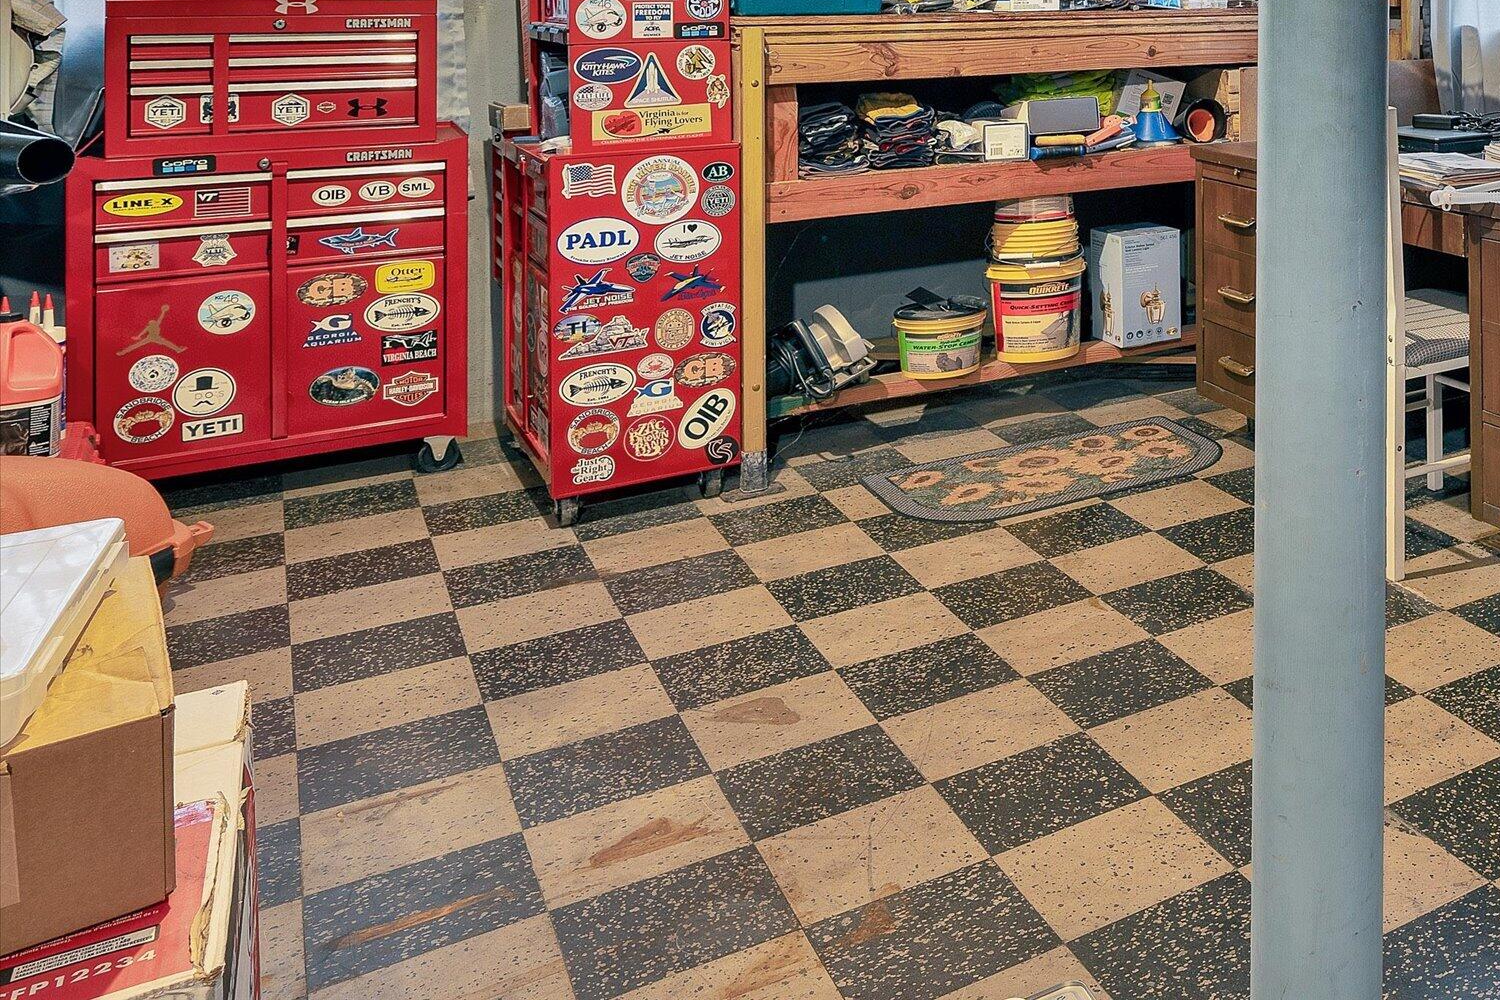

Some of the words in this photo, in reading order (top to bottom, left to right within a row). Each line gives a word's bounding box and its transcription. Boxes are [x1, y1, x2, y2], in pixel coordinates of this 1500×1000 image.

[346, 18, 412, 29] CRAFTSMAN
[602, 62, 627, 70] HAWK
[592, 69, 615, 77] KITES
[150, 108, 181, 116] YETI
[277, 106, 305, 114] YETI
[638, 110, 676, 119] Virginia
[644, 118, 673, 127] Flying
[674, 116, 703, 125] Lovers
[346, 149, 412, 162] CRAFTSMAN
[162, 159, 208, 167] GoPro
[708, 165, 729, 178] AB
[366, 185, 390, 197] VB
[402, 182, 431, 192] SML
[197, 192, 219, 202] VT
[318, 189, 346, 201] OIB
[682, 224, 686, 233] I
[566, 230, 632, 251] PADL
[684, 251, 707, 260] NOISE
[307, 278, 356, 300] CB
[1028, 283, 1070, 296] QUIKRETE
[383, 296, 422, 308] FRENCHY'S
[583, 297, 600, 306] JET
[606, 293, 633, 302] NOISE
[307, 331, 358, 341] GEORGIA
[608, 334, 635, 349] VT
[302, 337, 362, 348] AQUARIUM
[382, 350, 414, 363] VIRGINIA
[414, 348, 437, 360] BEACH
[579, 367, 617, 380] FRENCHY'S
[683, 358, 724, 380] CB
[116, 397, 172, 420] SANDBRIDGE
[570, 409, 617, 430] SANDBRIDGE
[684, 393, 729, 440] OIB
[185, 418, 240, 437] YETI
[130, 431, 162, 443] BEACH
[580, 443, 609, 454] BEACH
[577, 458, 599, 467] Just
[580, 464, 608, 476] Right
[573, 474, 598, 484] Gear
